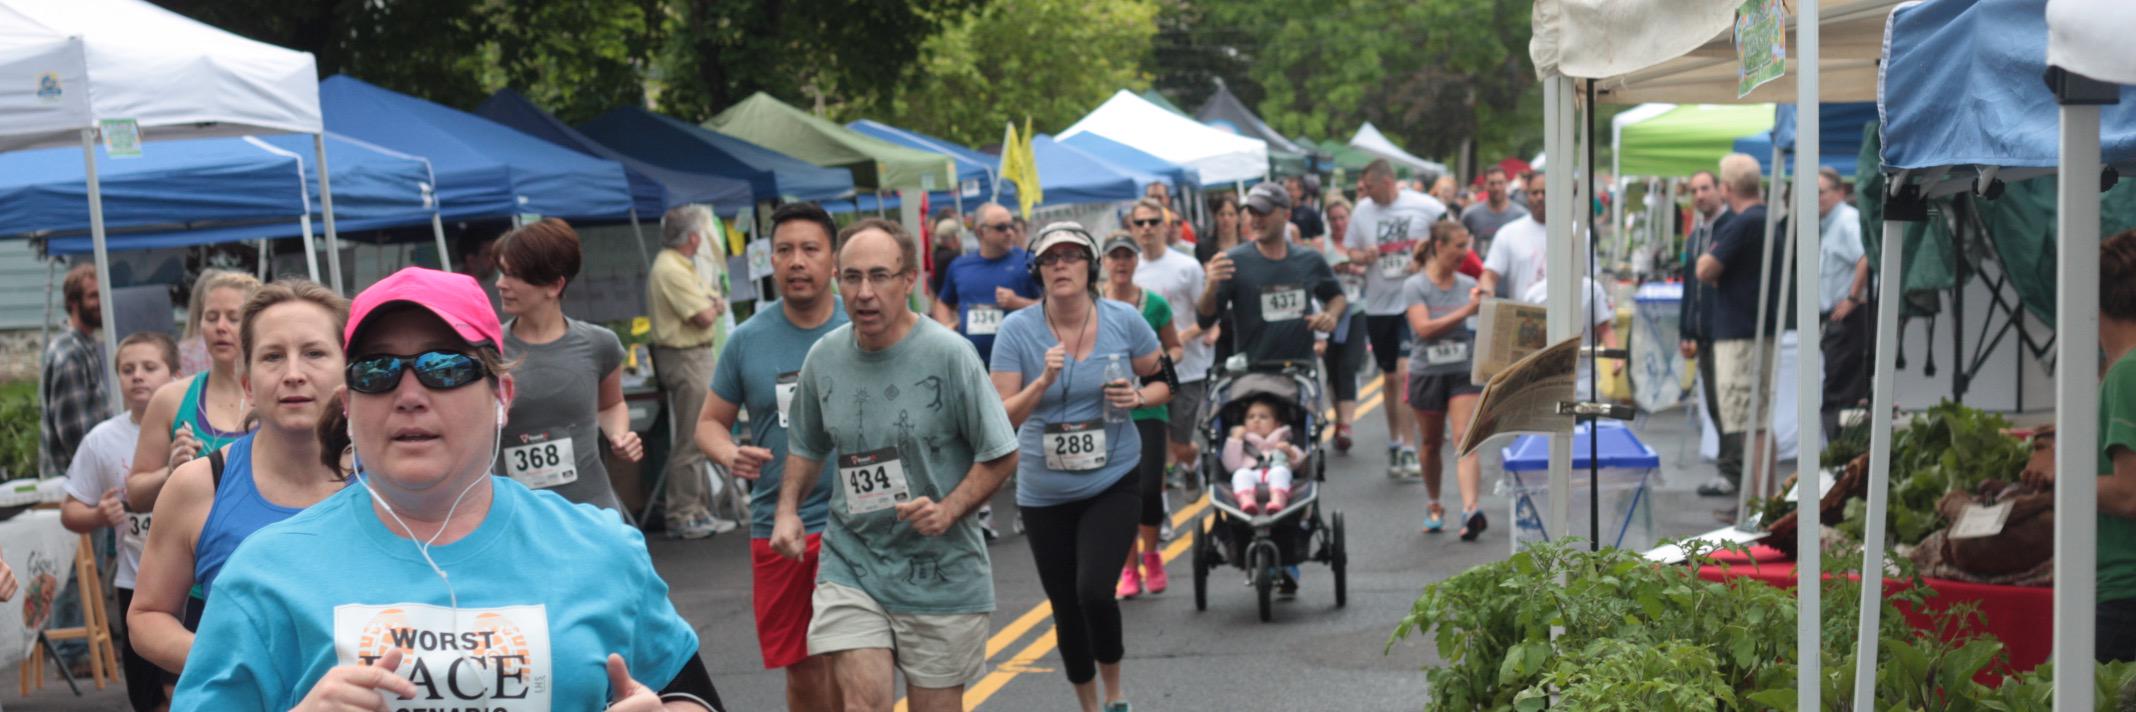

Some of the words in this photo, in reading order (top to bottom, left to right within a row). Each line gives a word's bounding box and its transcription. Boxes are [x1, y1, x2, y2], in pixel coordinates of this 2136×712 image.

[514, 444, 560, 471] 368
[1055, 434, 1094, 455] 288
[850, 466, 891, 494] 434
[390, 628, 495, 651] WORST
[359, 655, 529, 700] ACE
